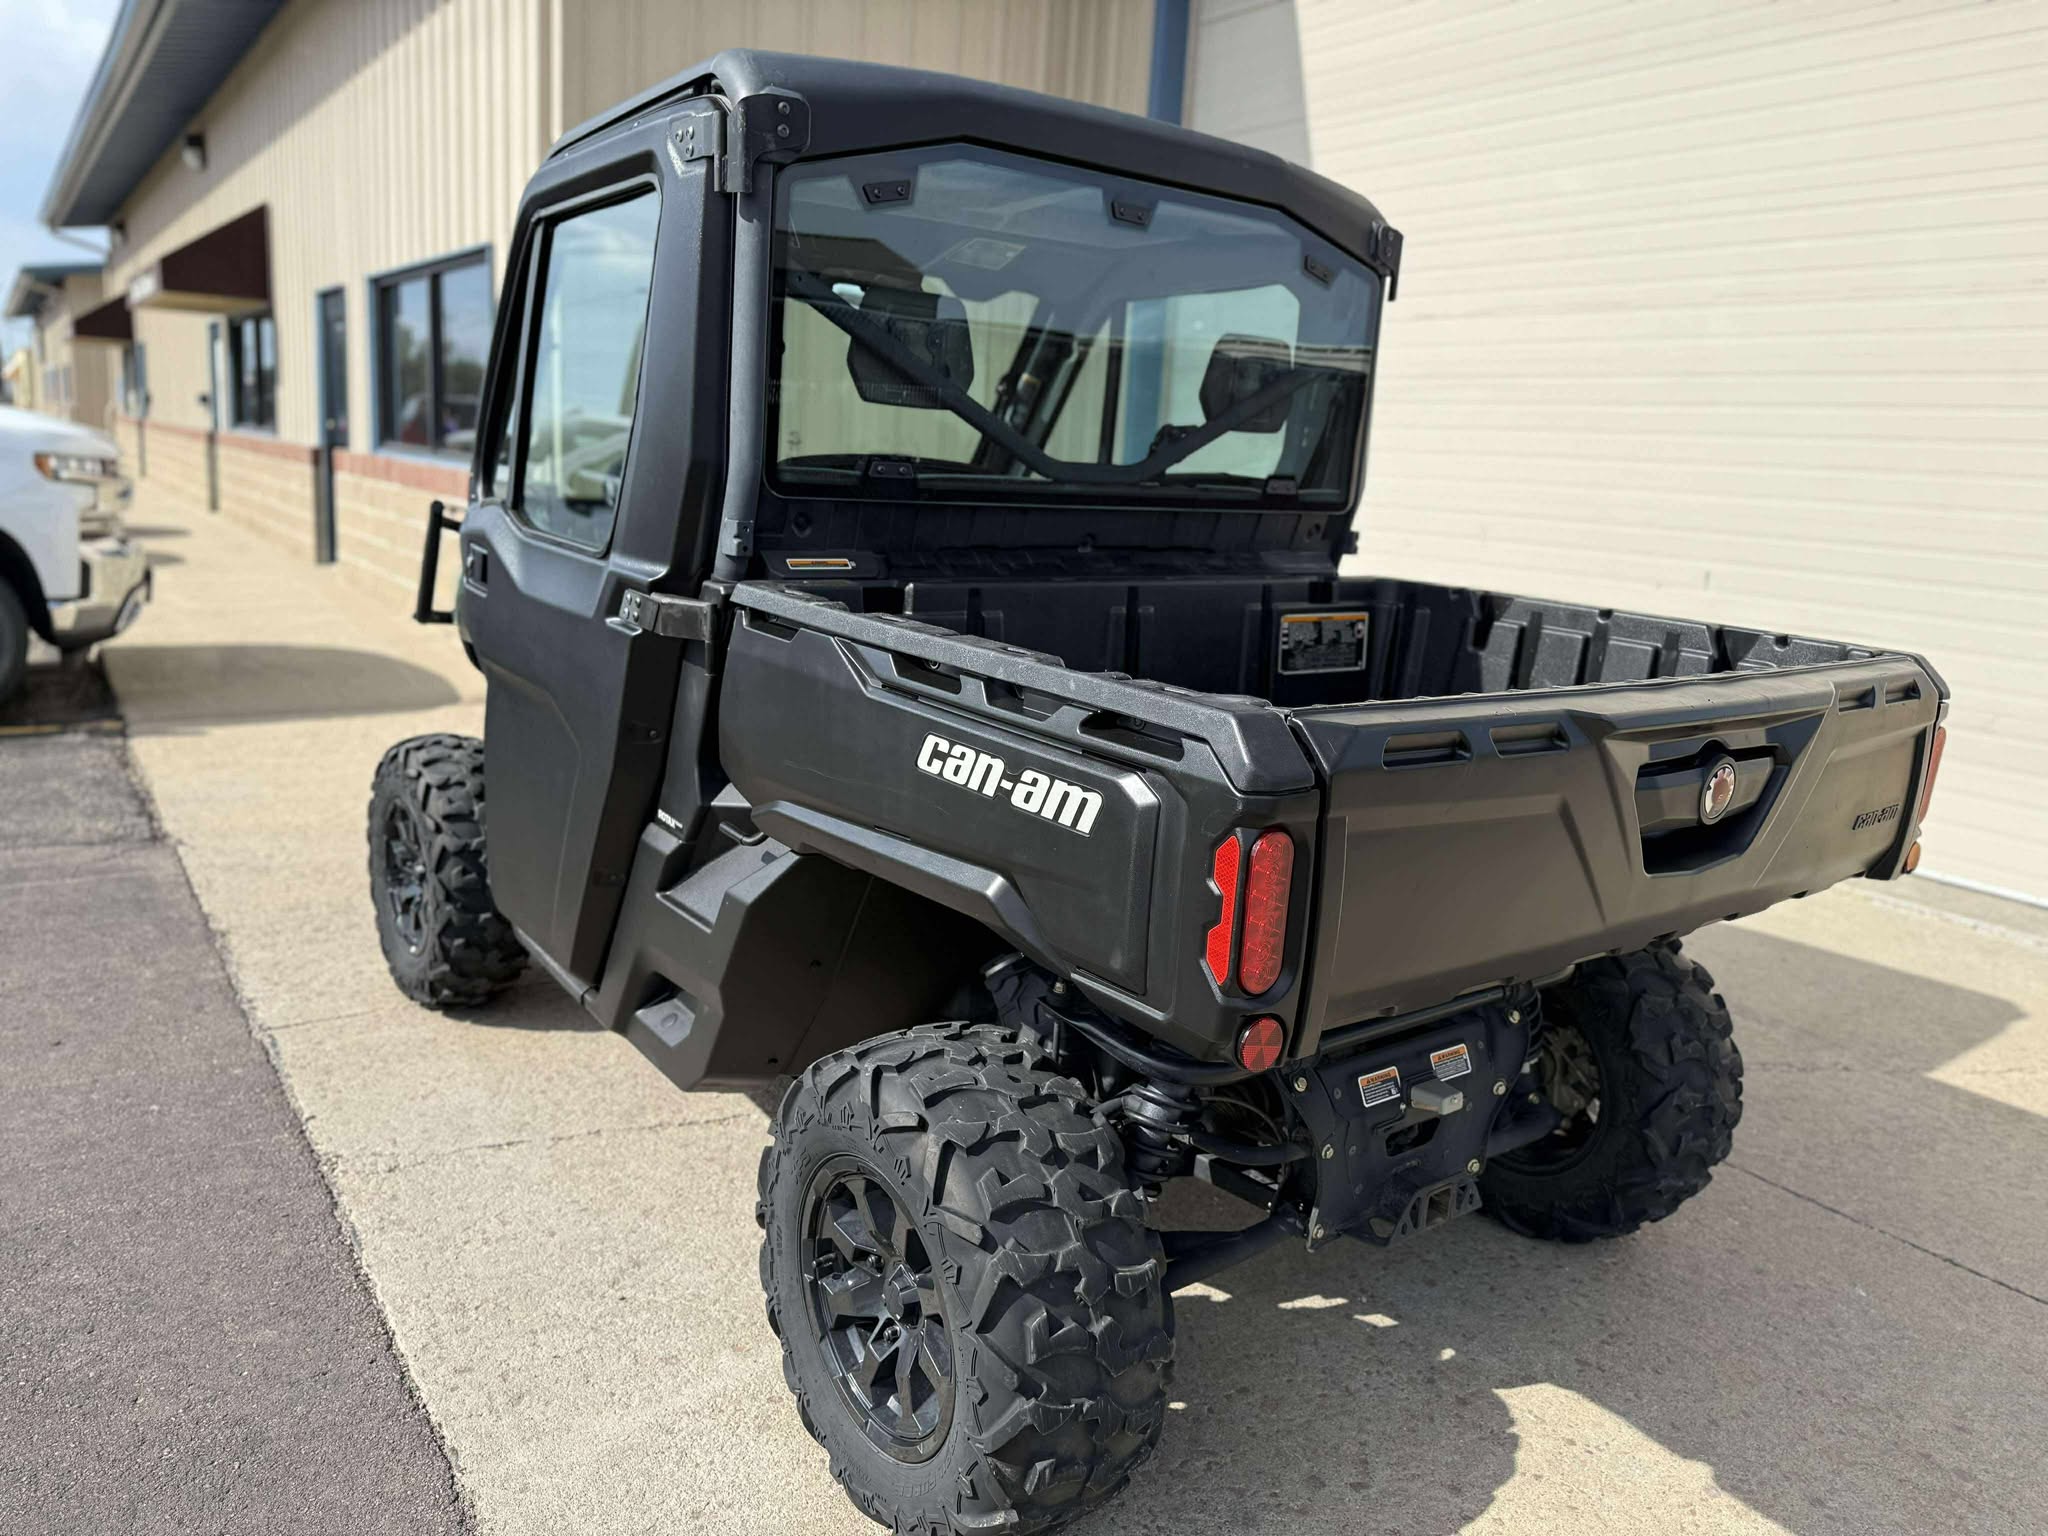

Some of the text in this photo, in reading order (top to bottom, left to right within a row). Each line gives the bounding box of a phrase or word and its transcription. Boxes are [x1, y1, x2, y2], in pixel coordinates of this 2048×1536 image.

[917, 734, 1102, 833] can-am
[1852, 804, 1899, 830] can-am
[1371, 1072, 1392, 1083] WARNING
